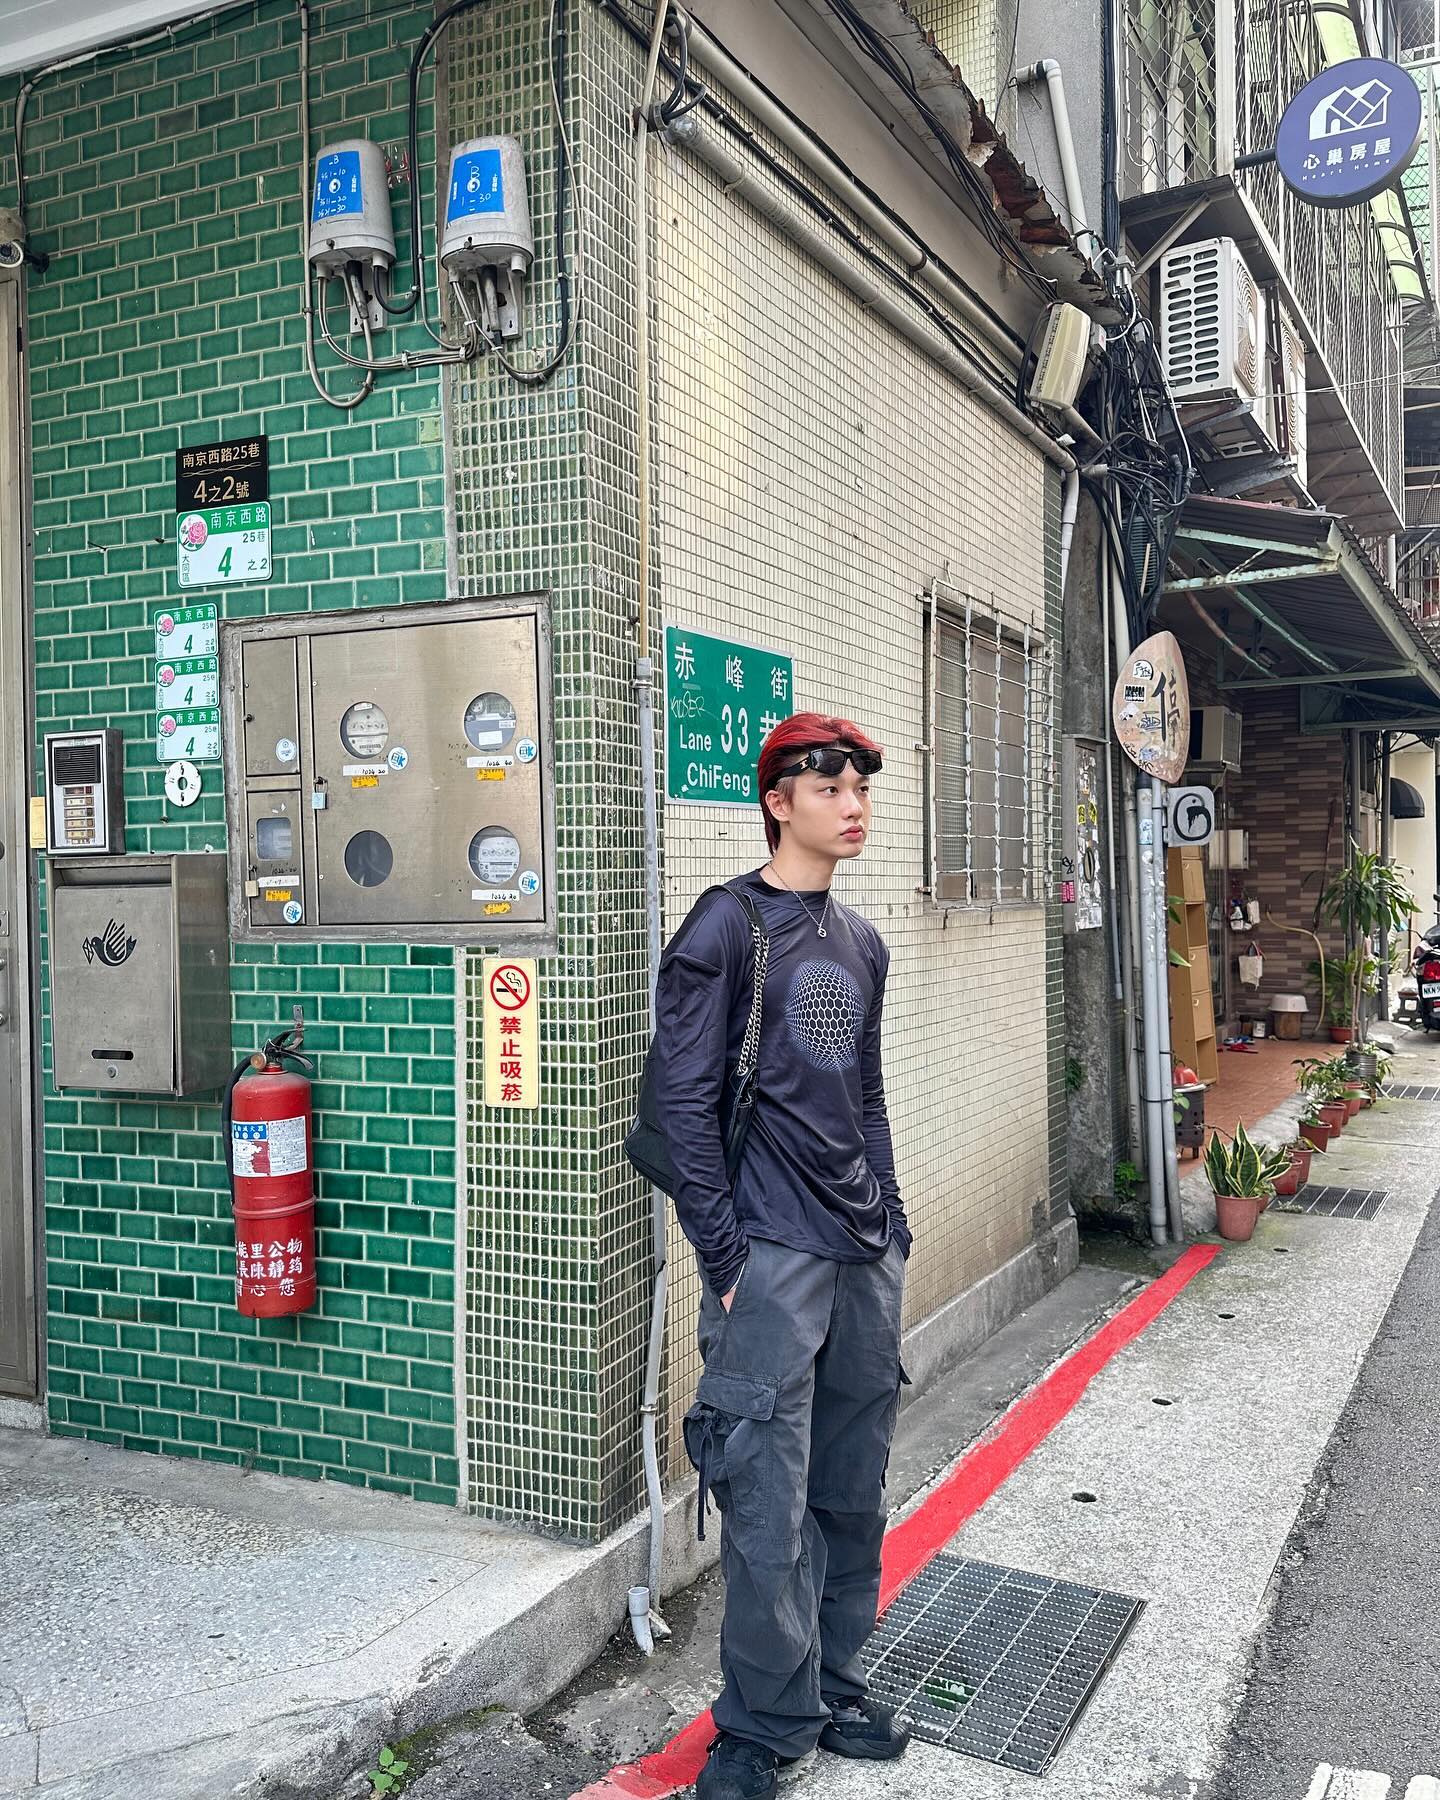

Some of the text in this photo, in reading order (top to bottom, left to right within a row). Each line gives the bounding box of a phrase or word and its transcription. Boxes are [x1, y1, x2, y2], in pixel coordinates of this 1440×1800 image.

[1303, 138, 1391, 170] 心巢房屋
[182, 443, 260, 469] 南京西路25巷
[193, 476, 250, 503] 4之2號
[210, 507, 267, 529] 南京西路
[242, 531, 266, 544] 25巷
[217, 546, 233, 578] 4
[247, 558, 268, 571] 之2
[173, 606, 215, 622] 南京西路
[183, 634, 193, 654] 4
[174, 659, 216, 674] 南京西路
[674, 643, 788, 701] 赤峰街
[184, 686, 193, 705] 4
[176, 711, 218, 724] 南京西路
[185, 737, 194, 756] 4
[680, 725, 712, 752] Lane
[687, 762, 750, 797] ChiFeng
[499, 1016, 522, 1101] 禁止吸菸
